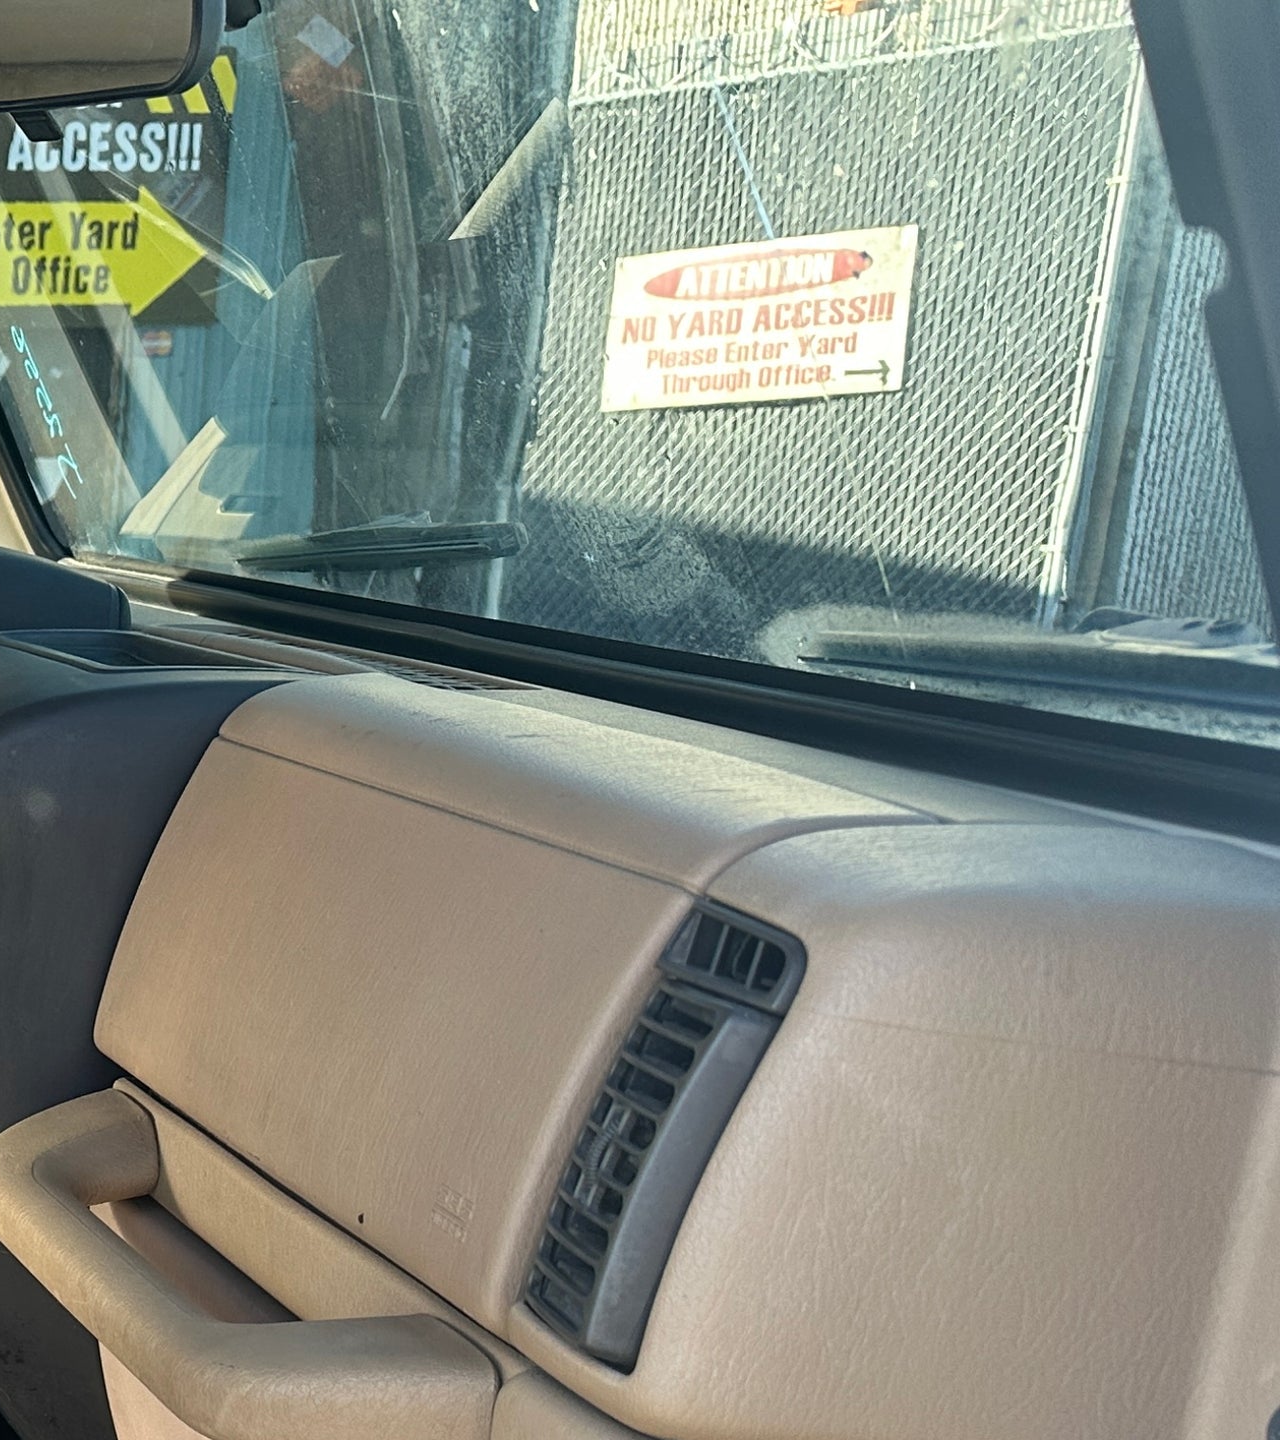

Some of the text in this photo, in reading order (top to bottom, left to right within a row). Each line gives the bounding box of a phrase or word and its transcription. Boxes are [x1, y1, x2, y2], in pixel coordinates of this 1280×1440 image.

[7, 121, 203, 172] ACCESS!!!
[69, 212, 139, 251] Yard
[11, 255, 109, 296] Office
[675, 252, 835, 298] ATTENTION
[621, 291, 896, 344] NO YARD ACCESS!!!
[646, 332, 858, 369] Please Enter Yard
[661, 367, 751, 395] Through
